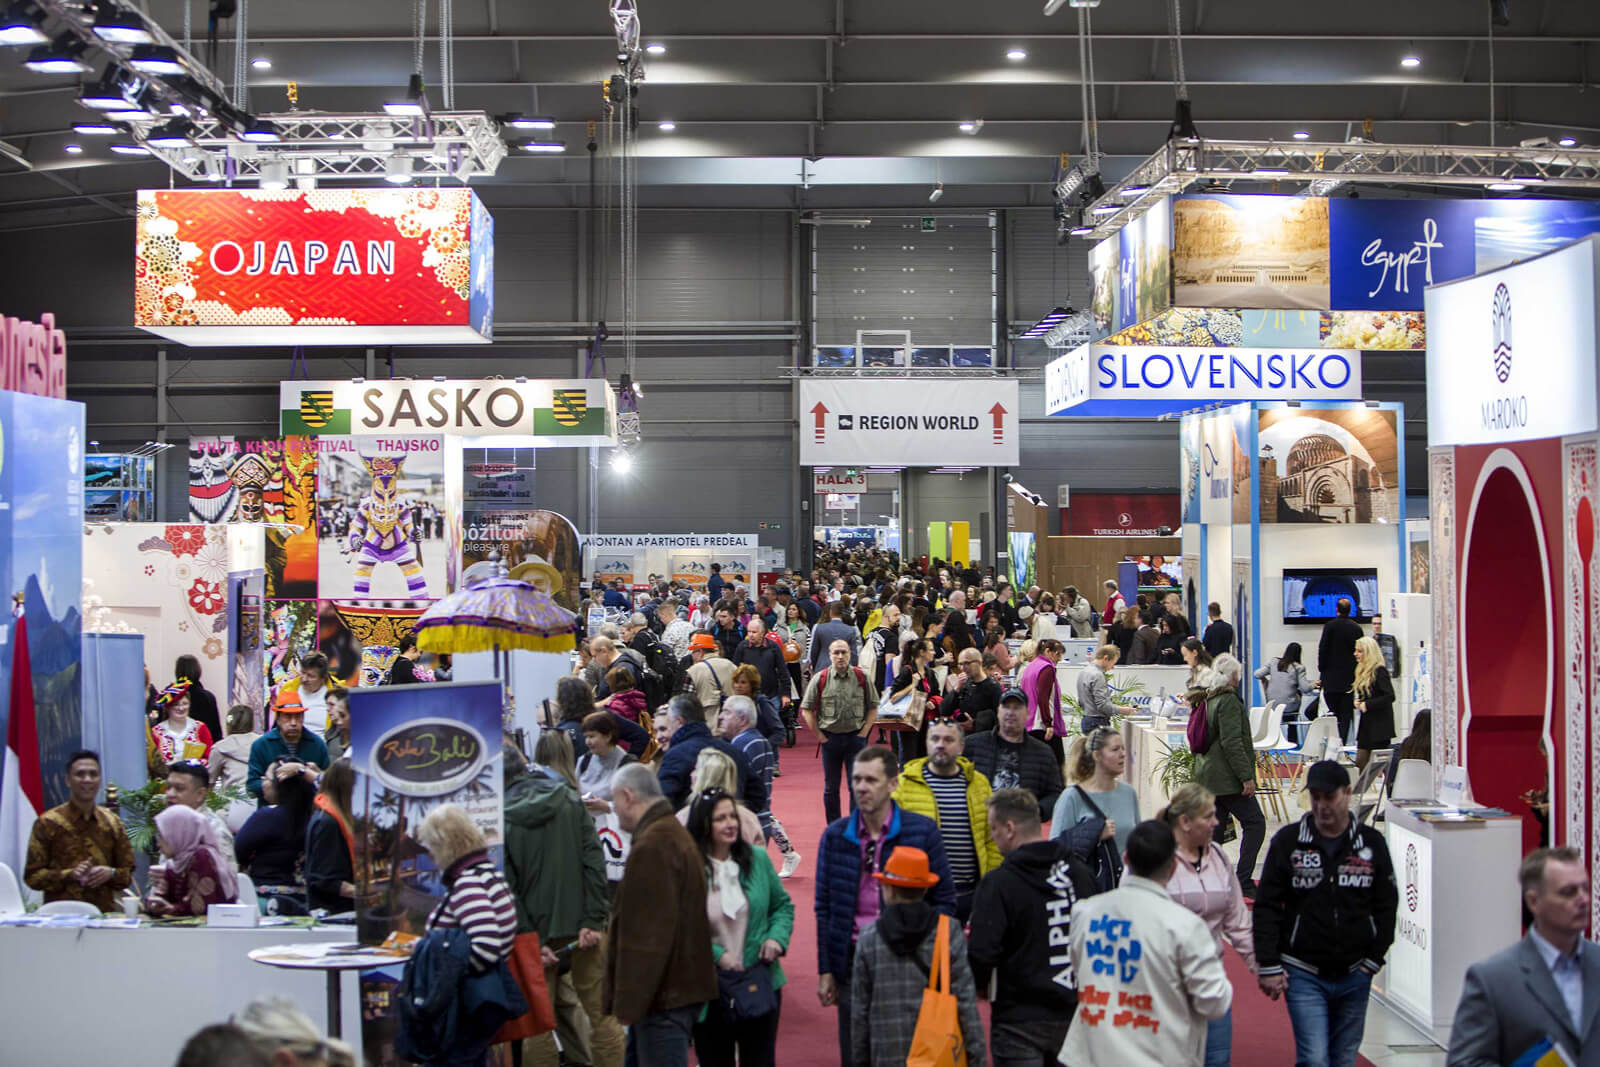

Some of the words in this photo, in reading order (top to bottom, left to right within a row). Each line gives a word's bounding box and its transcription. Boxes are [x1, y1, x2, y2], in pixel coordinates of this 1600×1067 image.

[1098, 353, 1351, 390] SLOVENSKO
[361, 387, 524, 428] SASKO
[1481, 395, 1528, 430] MAROKO
[859, 415, 918, 431] REGION
[924, 415, 979, 431] WORLD
[290, 440, 356, 453] FESTIVAL
[376, 439, 440, 451] THAJSKO
[816, 475, 853, 485] HALA
[857, 474, 865, 485] 3
[1093, 528, 1125, 536] TURKISH
[1125, 528, 1158, 536] AIRLINES
[464, 542, 509, 552] pleasure
[636, 537, 700, 547] APARTHOTEL
[703, 537, 748, 547] PREDEAL
